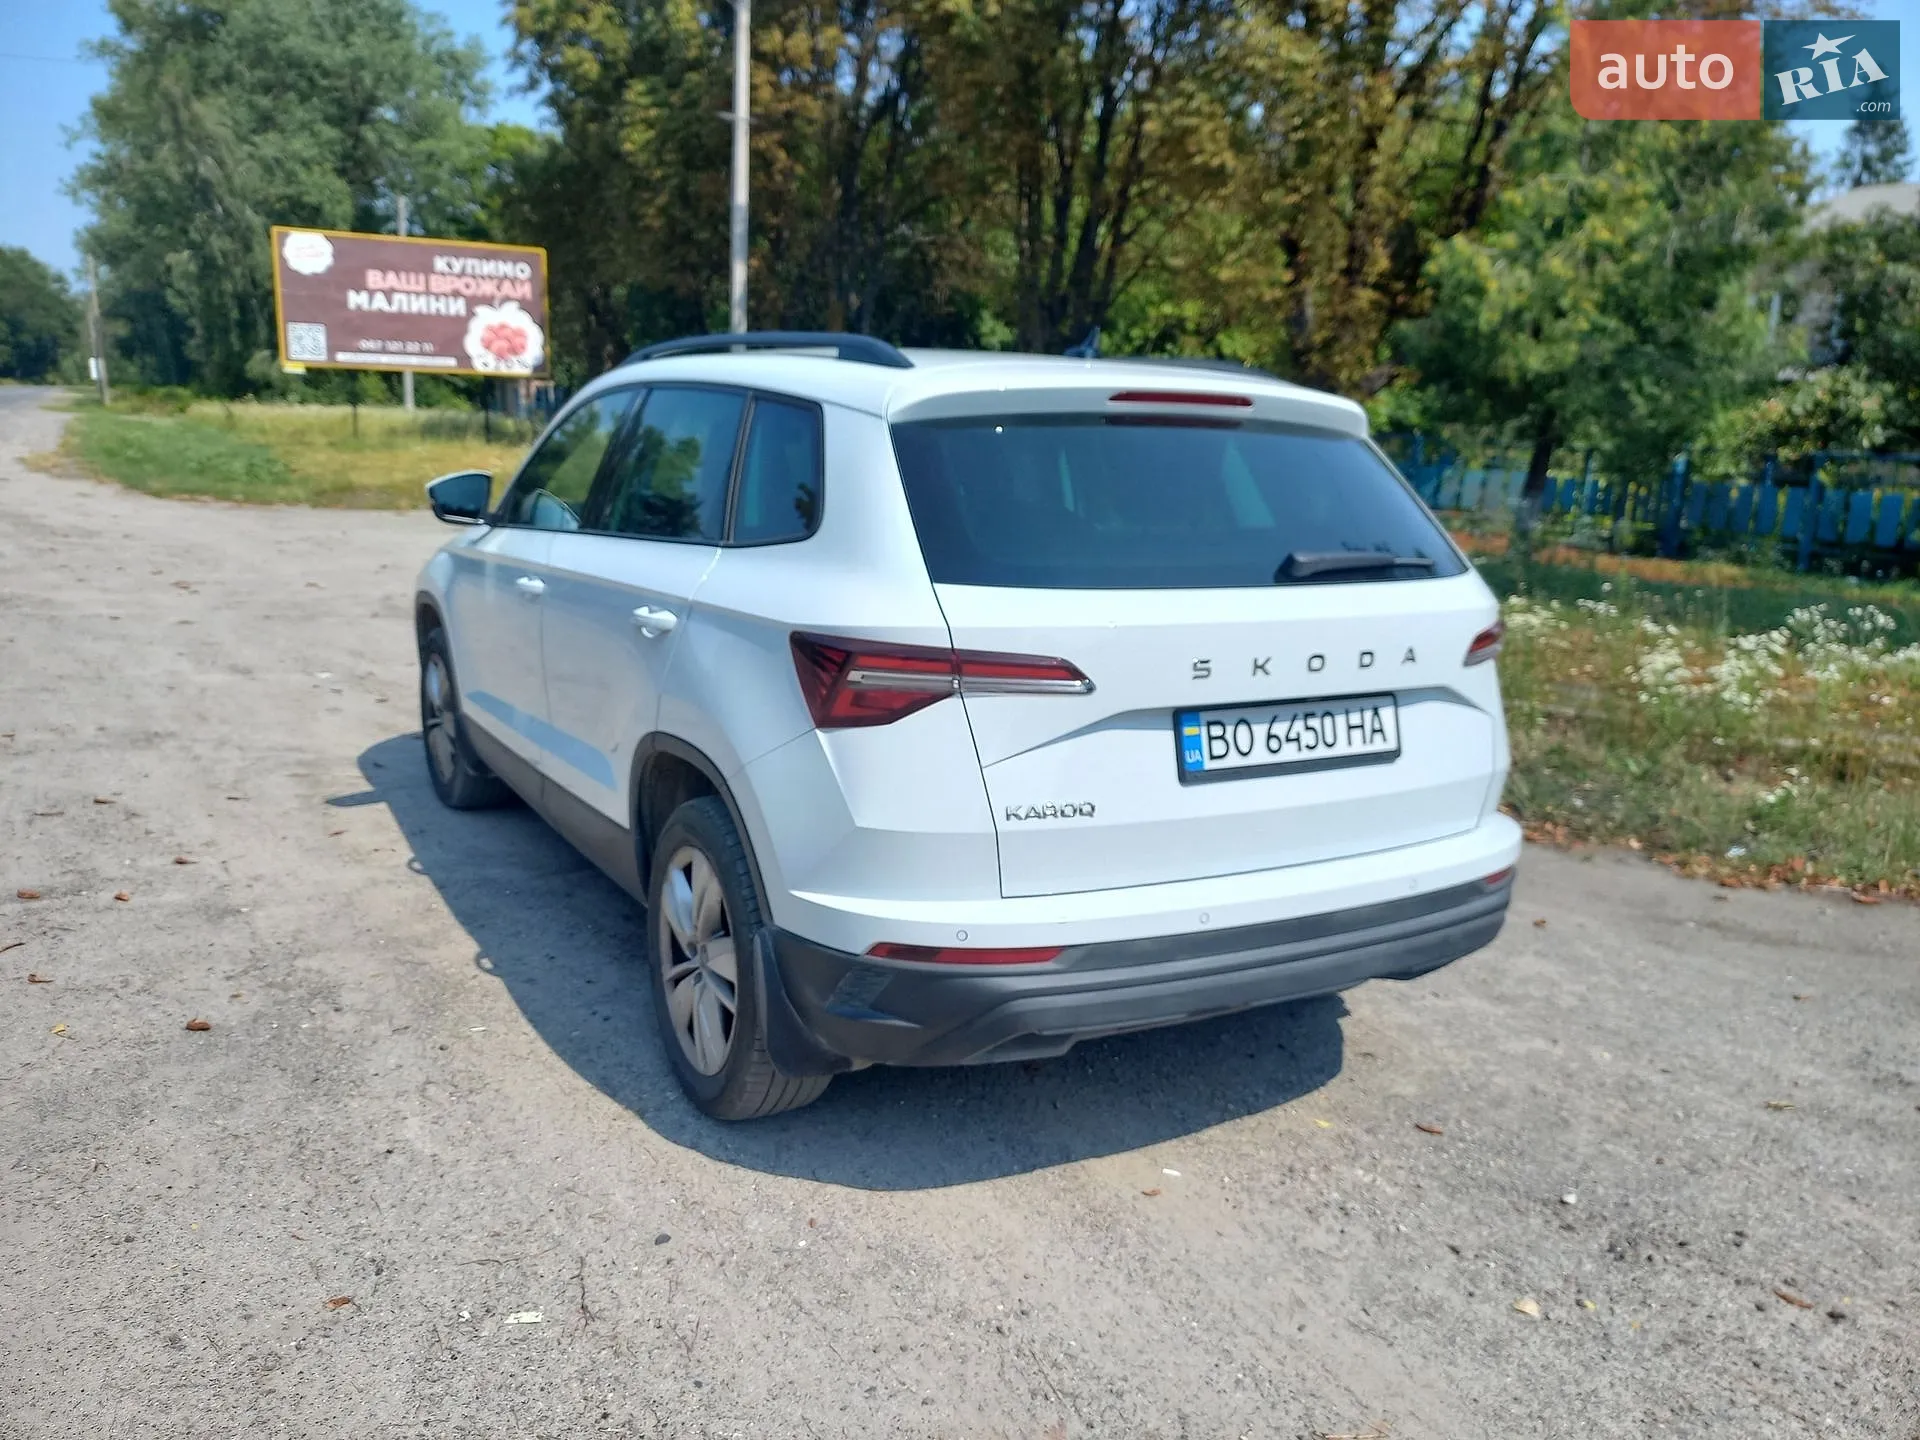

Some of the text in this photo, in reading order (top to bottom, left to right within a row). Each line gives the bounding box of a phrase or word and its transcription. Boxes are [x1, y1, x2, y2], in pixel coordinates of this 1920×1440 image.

[365, 268, 426, 293] ВАШ
[346, 288, 468, 317] МАЛИНИ
[1192, 647, 1417, 680] SKODA
[1206, 707, 1388, 760] BO 6450 HA
[1185, 749, 1204, 764] UA
[1005, 801, 1096, 821] KAROQ
